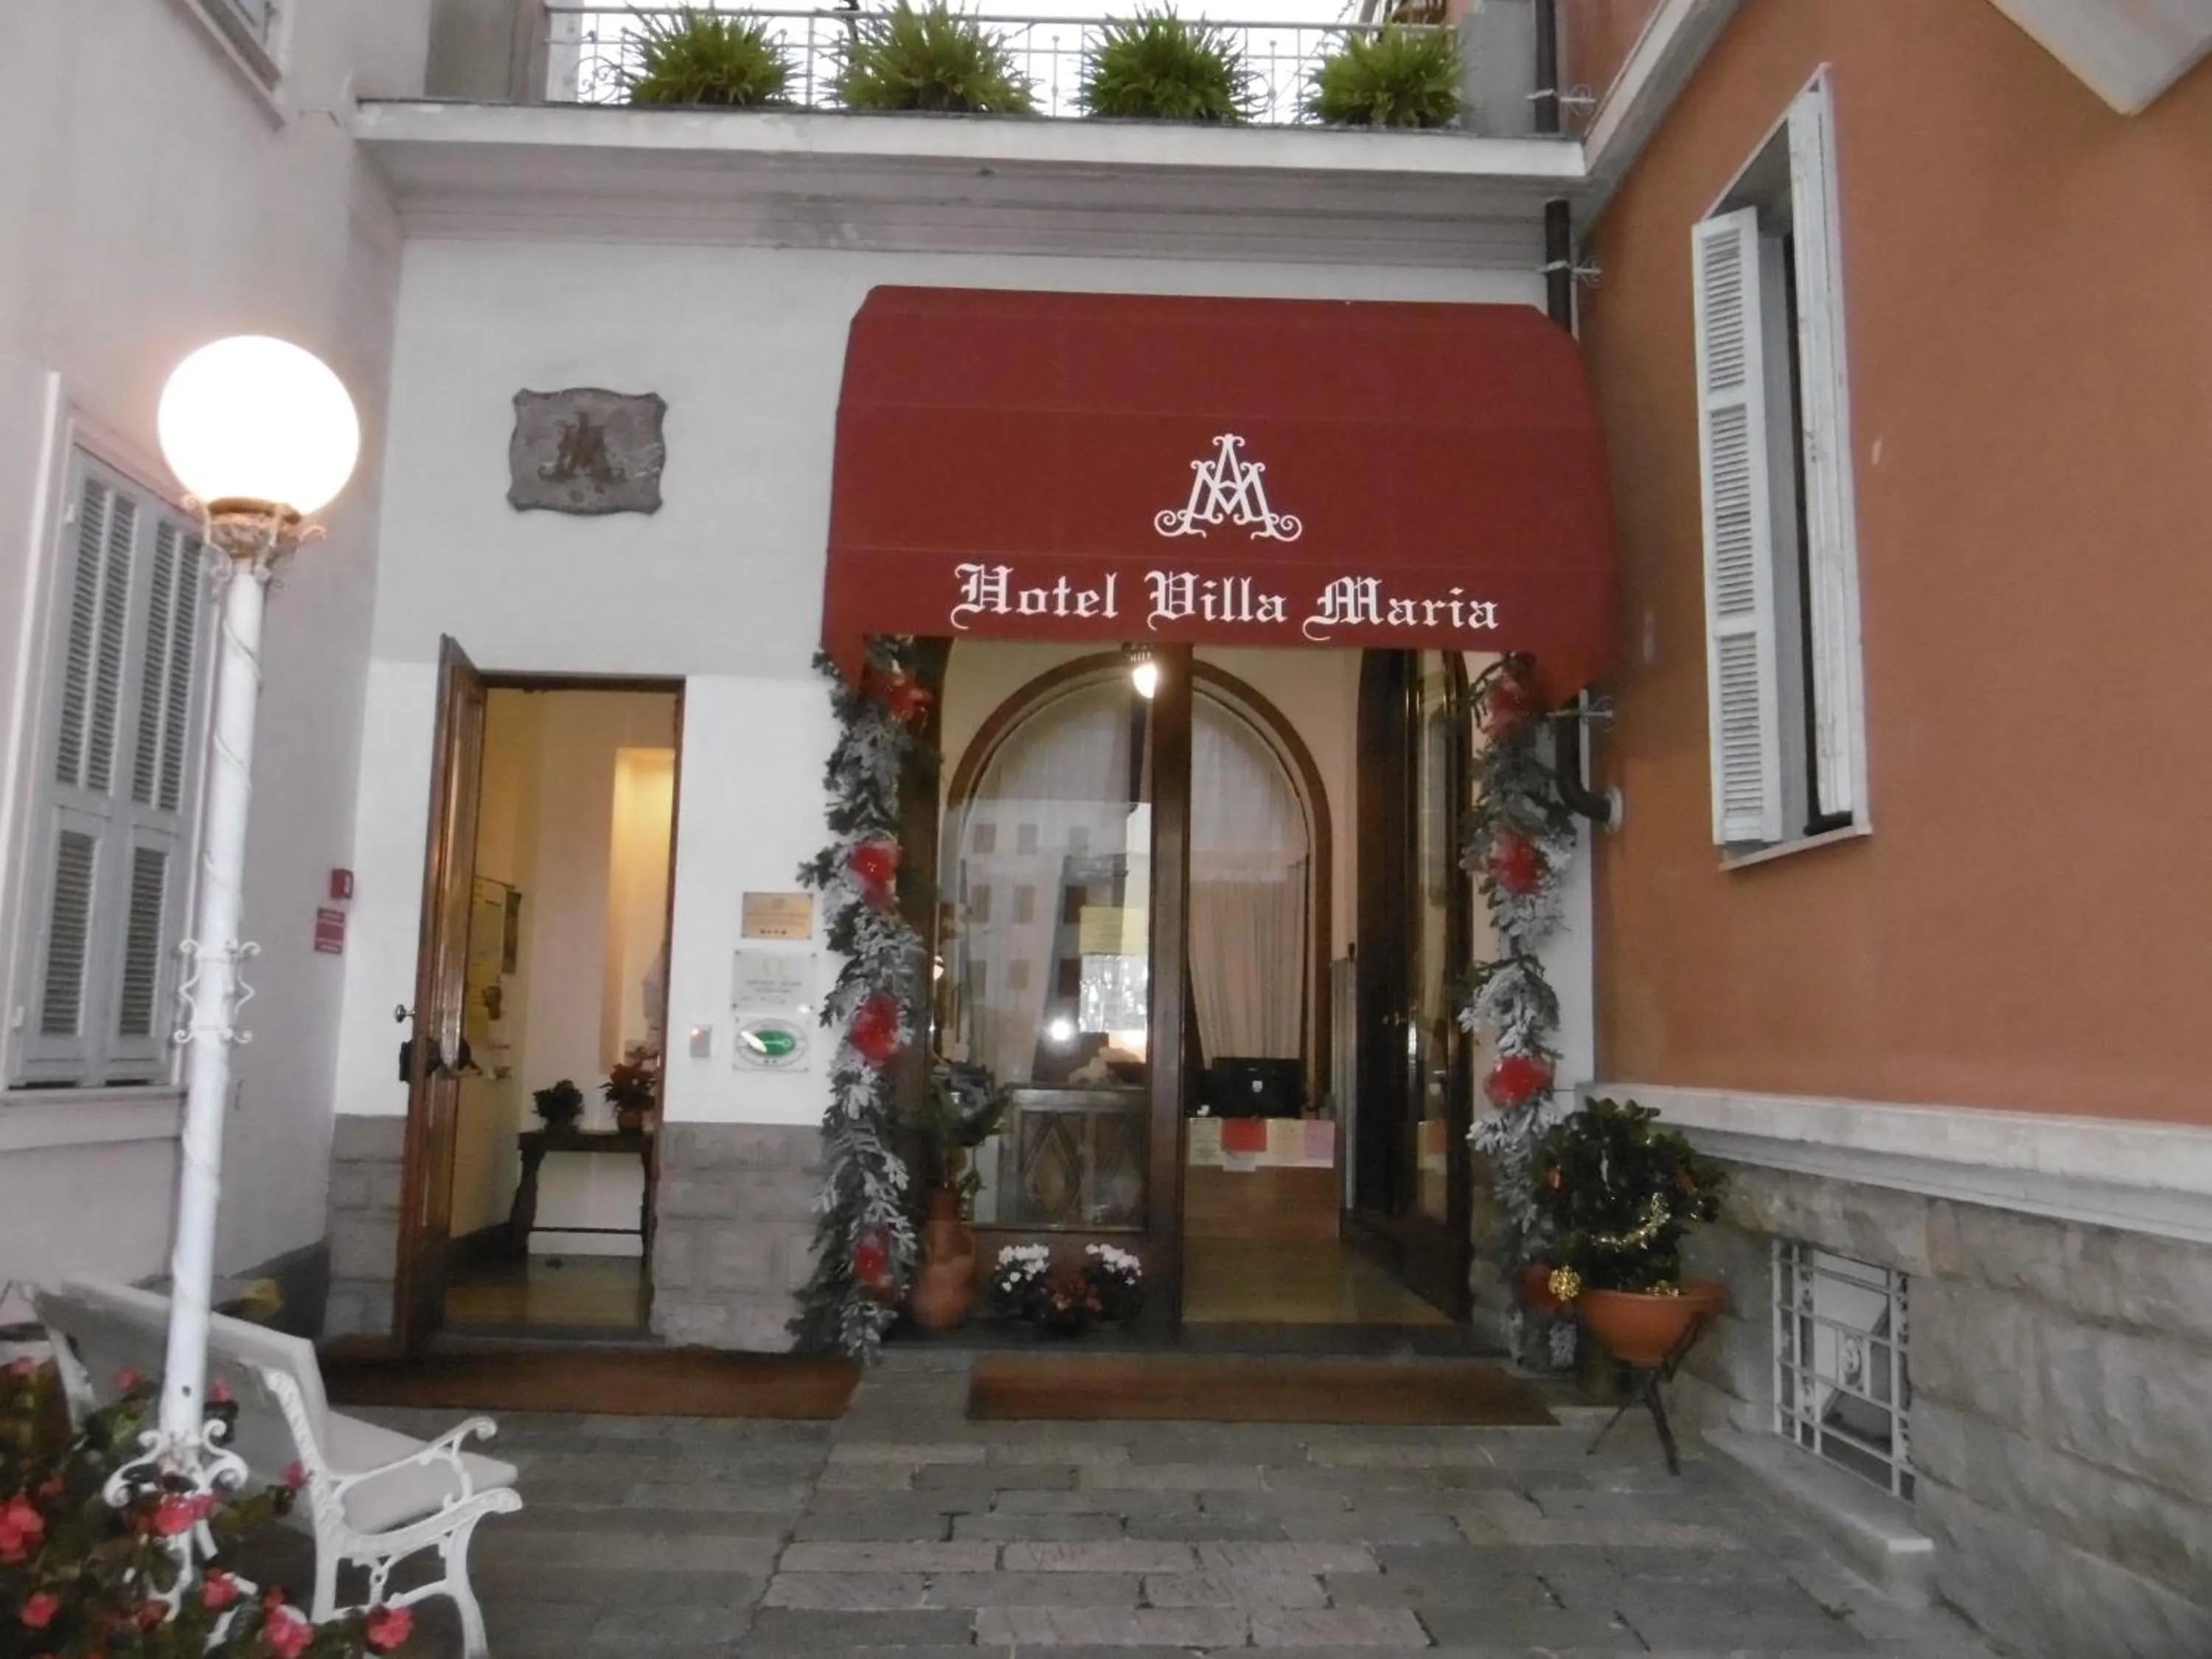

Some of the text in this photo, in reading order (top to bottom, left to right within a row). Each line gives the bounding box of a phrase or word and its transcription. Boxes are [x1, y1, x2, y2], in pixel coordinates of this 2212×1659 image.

[950, 563, 1499, 641] Hotel Villa Maria
